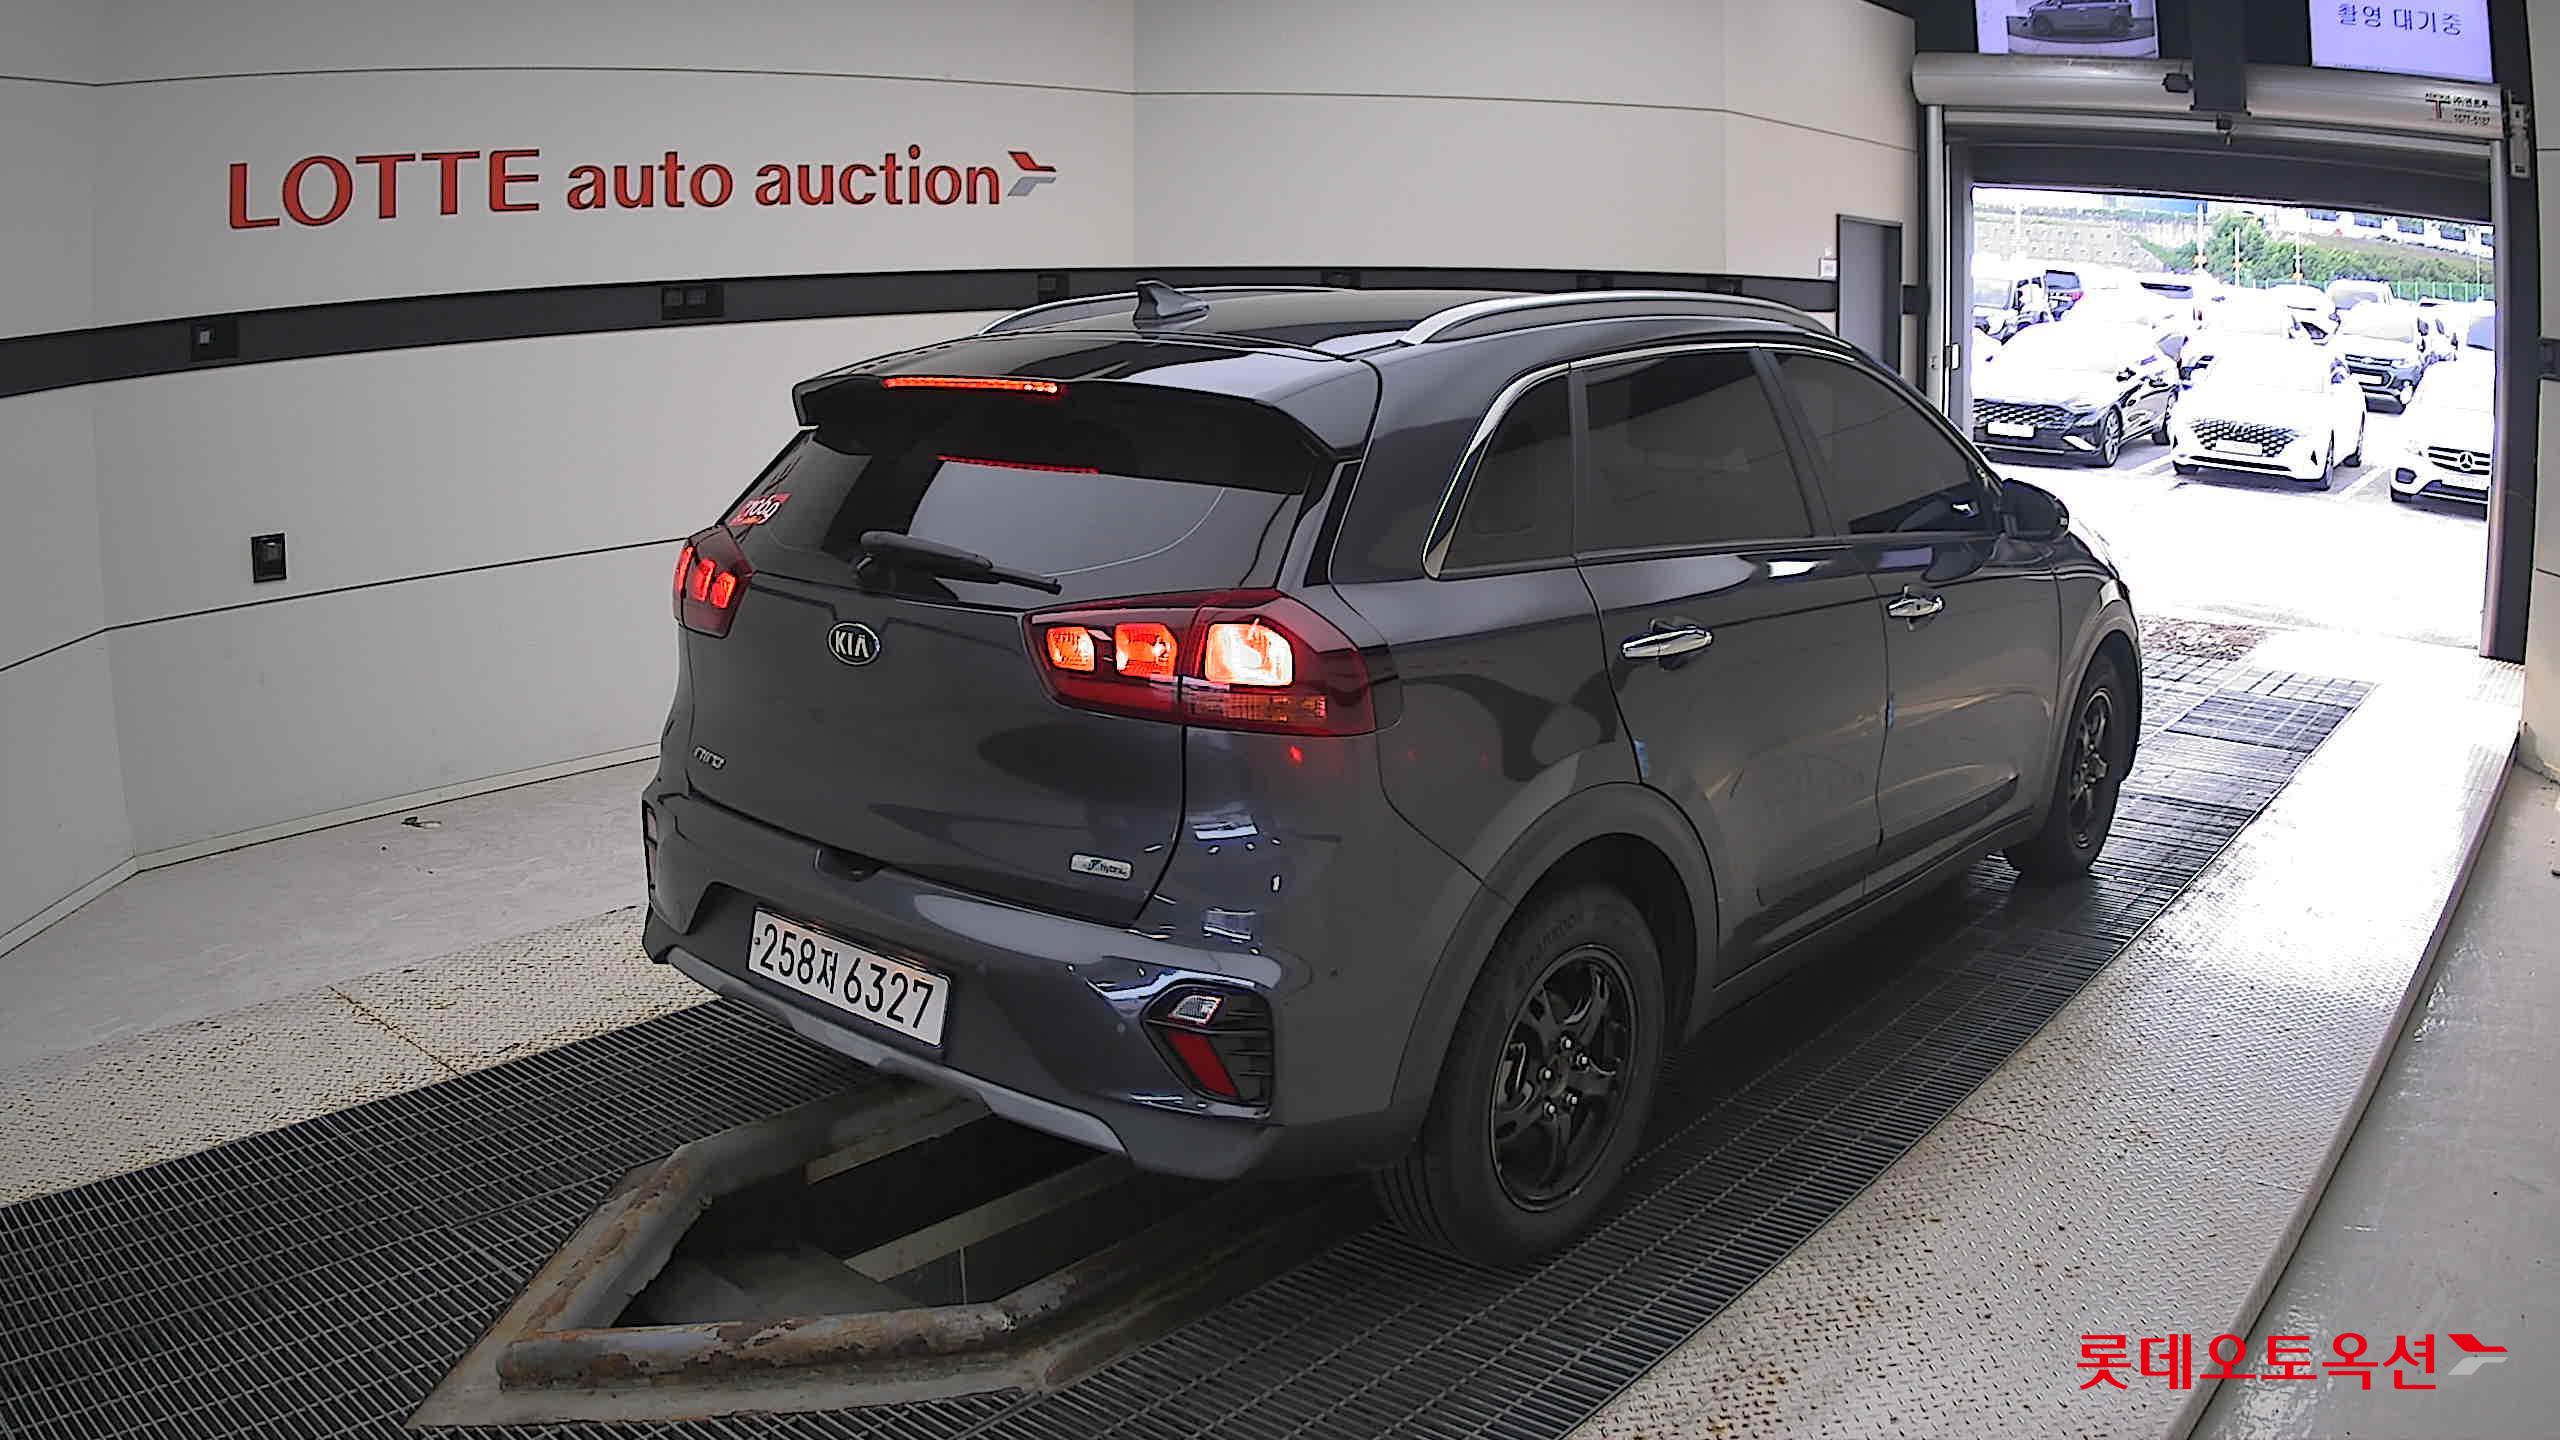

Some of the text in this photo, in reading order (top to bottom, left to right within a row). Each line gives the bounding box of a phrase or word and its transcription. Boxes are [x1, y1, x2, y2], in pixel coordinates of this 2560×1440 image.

[2338, 4, 2462, 36] 촬영 대기중
[228, 144, 1001, 231] LOTTE auto auction
[835, 630, 870, 659] KIA
